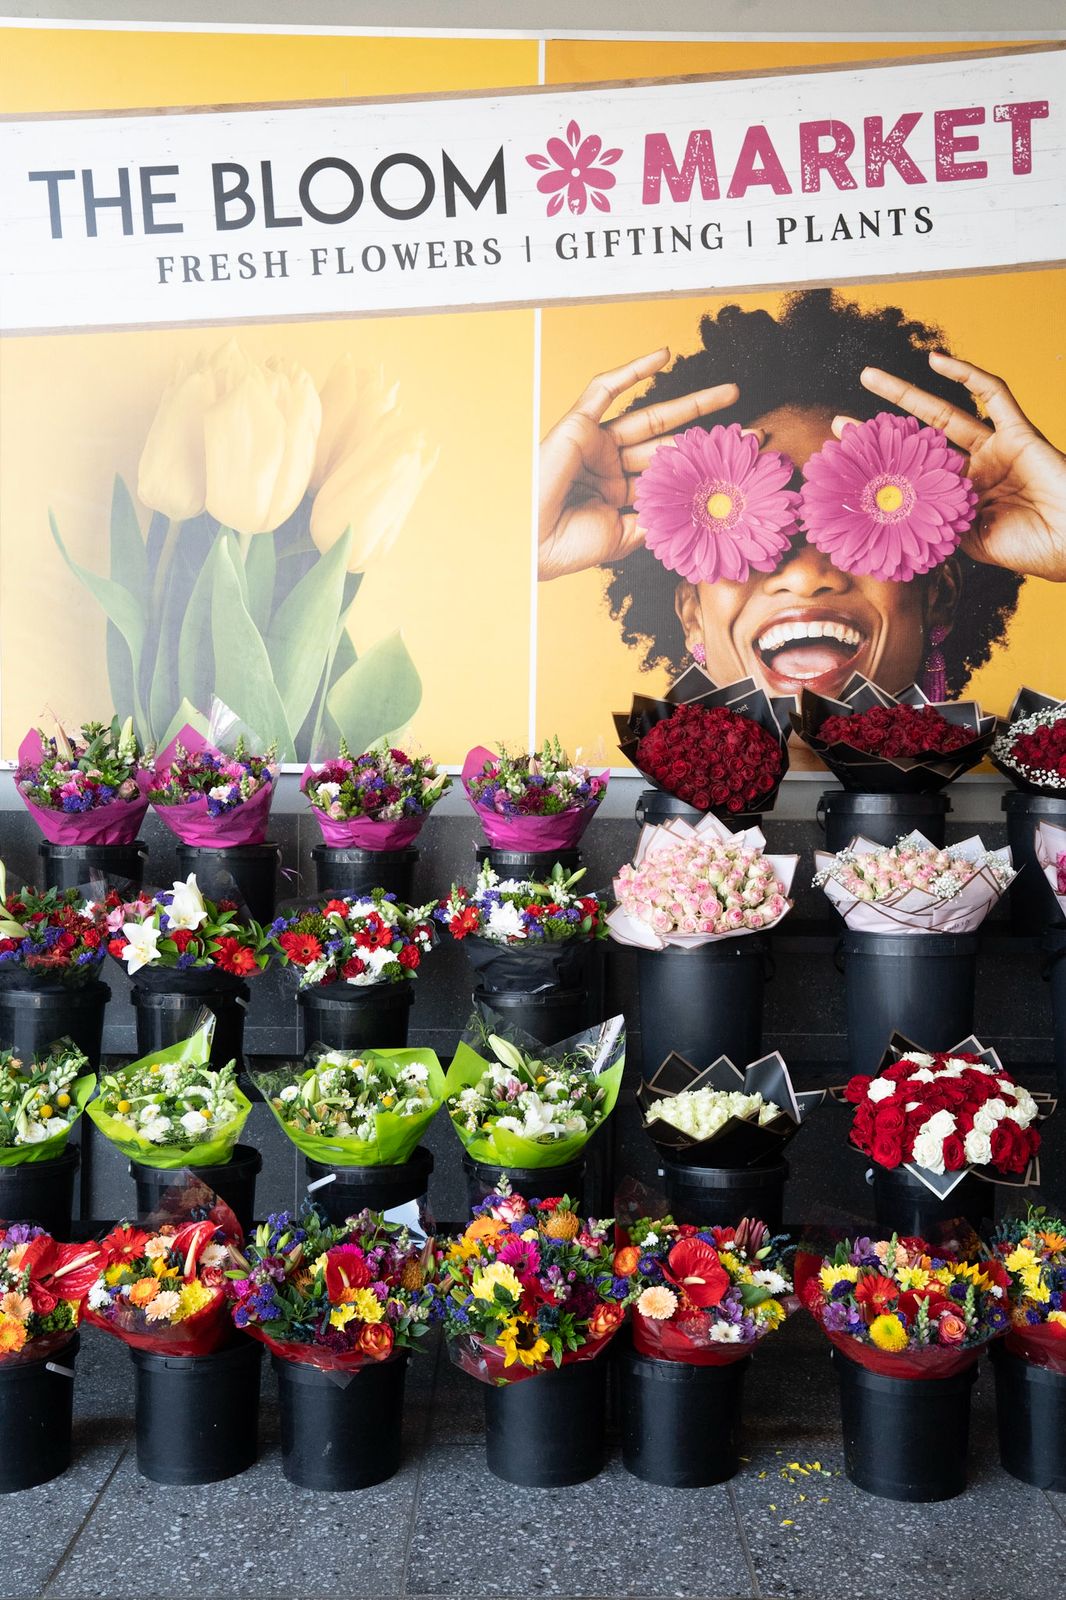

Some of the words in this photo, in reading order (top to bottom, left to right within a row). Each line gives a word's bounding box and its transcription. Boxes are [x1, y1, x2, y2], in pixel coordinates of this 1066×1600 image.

[28, 165, 184, 239] THE
[211, 144, 508, 231] BLOOM
[642, 100, 1049, 205] MARKET
[156, 250, 290, 284] FRESH
[310, 237, 503, 276] FLOWERS
[555, 222, 723, 260] GIFTING
[776, 206, 934, 245] PLANTS
